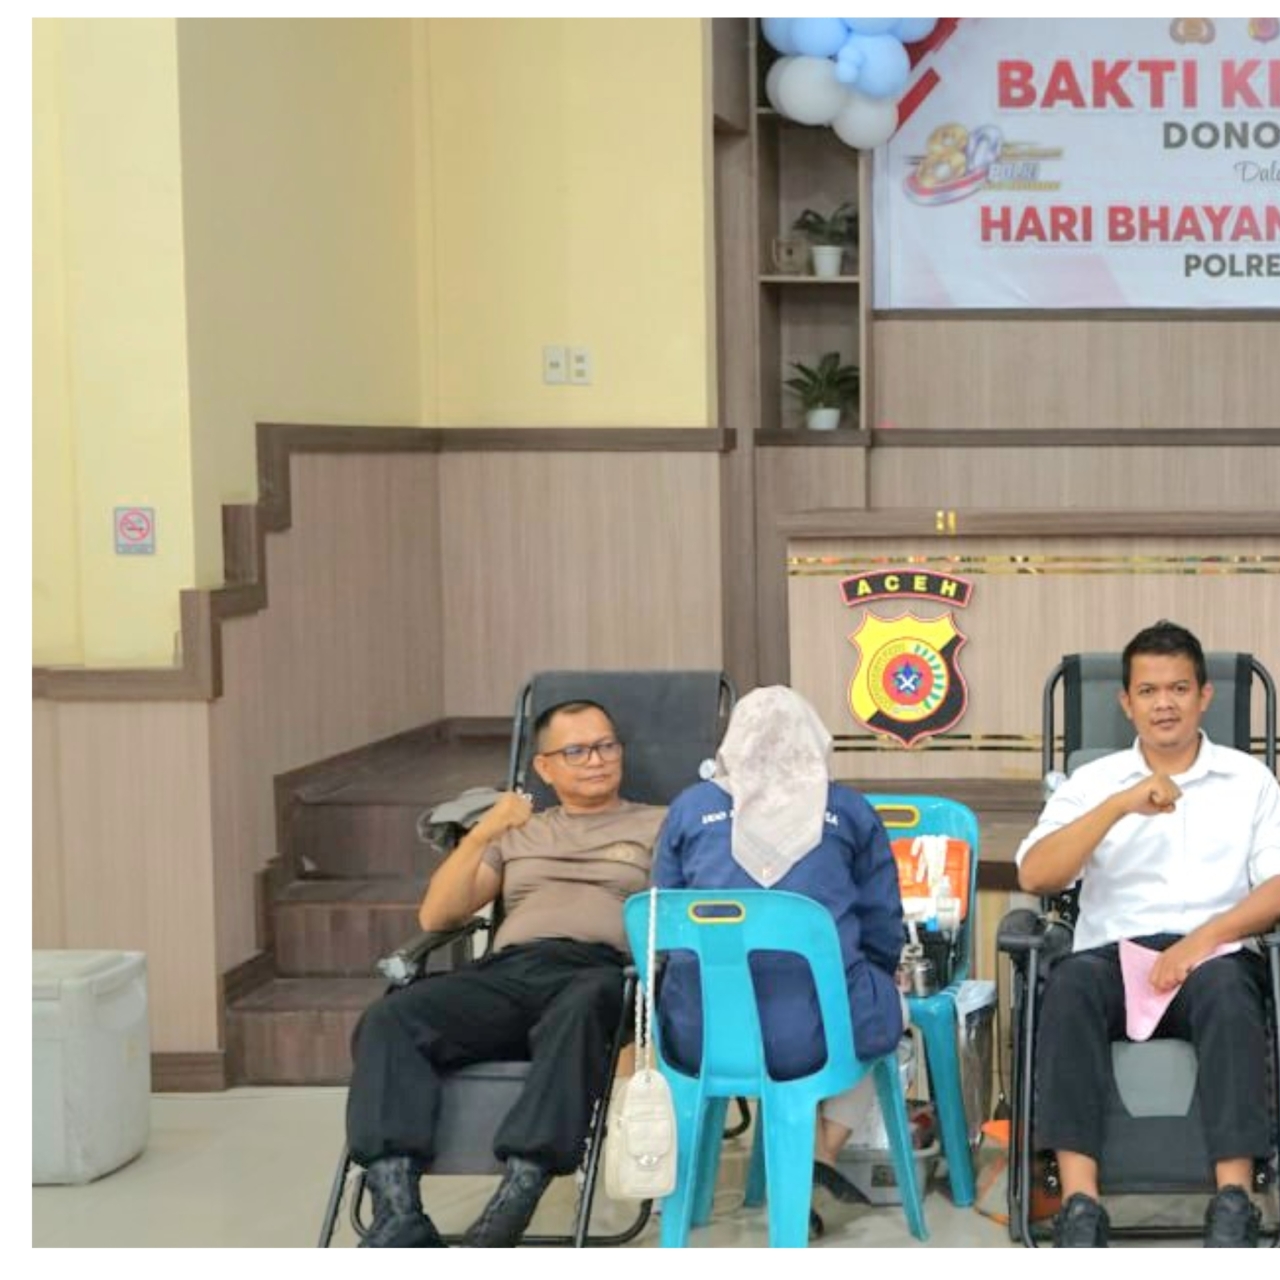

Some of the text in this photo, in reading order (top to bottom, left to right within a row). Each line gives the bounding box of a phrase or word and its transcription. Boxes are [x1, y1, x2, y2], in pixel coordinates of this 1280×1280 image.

[997, 59, 1198, 109] BAKTI
[980, 205, 1092, 242] HARI
[857, 575, 957, 597] ACEH
